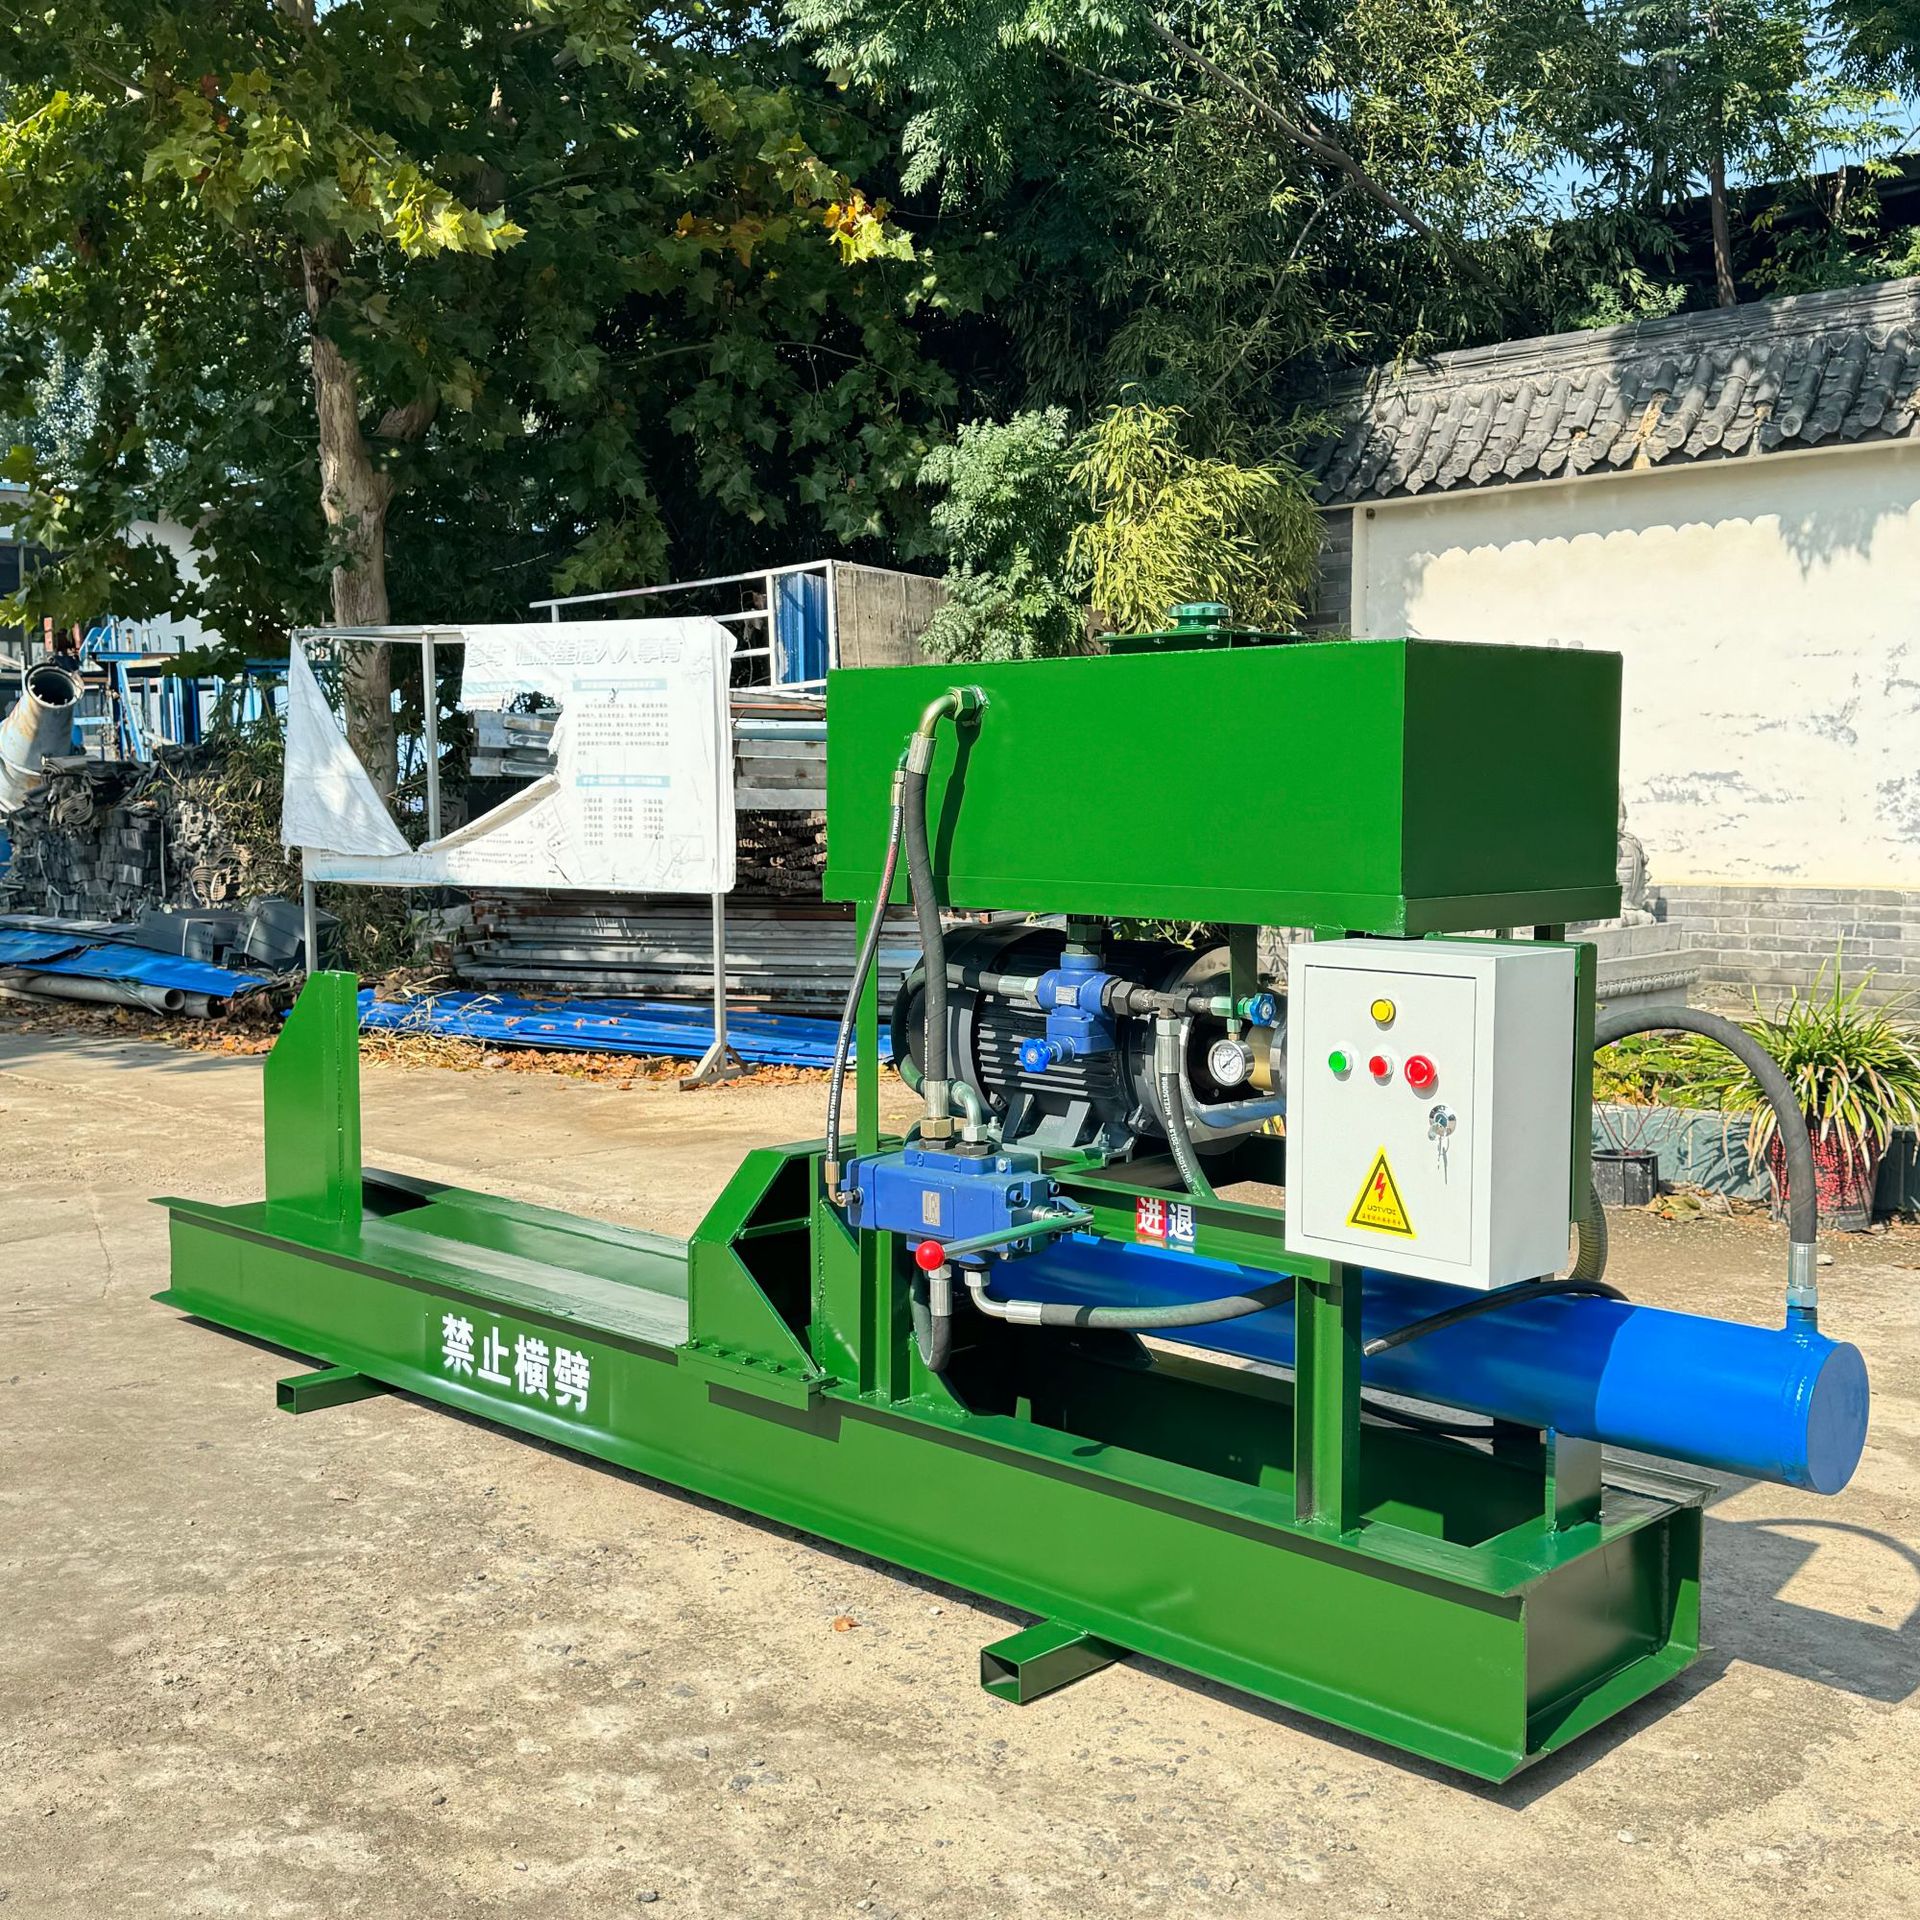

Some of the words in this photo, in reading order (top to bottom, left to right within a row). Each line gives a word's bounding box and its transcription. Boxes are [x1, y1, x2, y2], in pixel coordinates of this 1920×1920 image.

[1138, 1197, 1164, 1235] 进
[1168, 1203, 1195, 1242] 退
[442, 1313, 590, 1413] 禁止横劈
